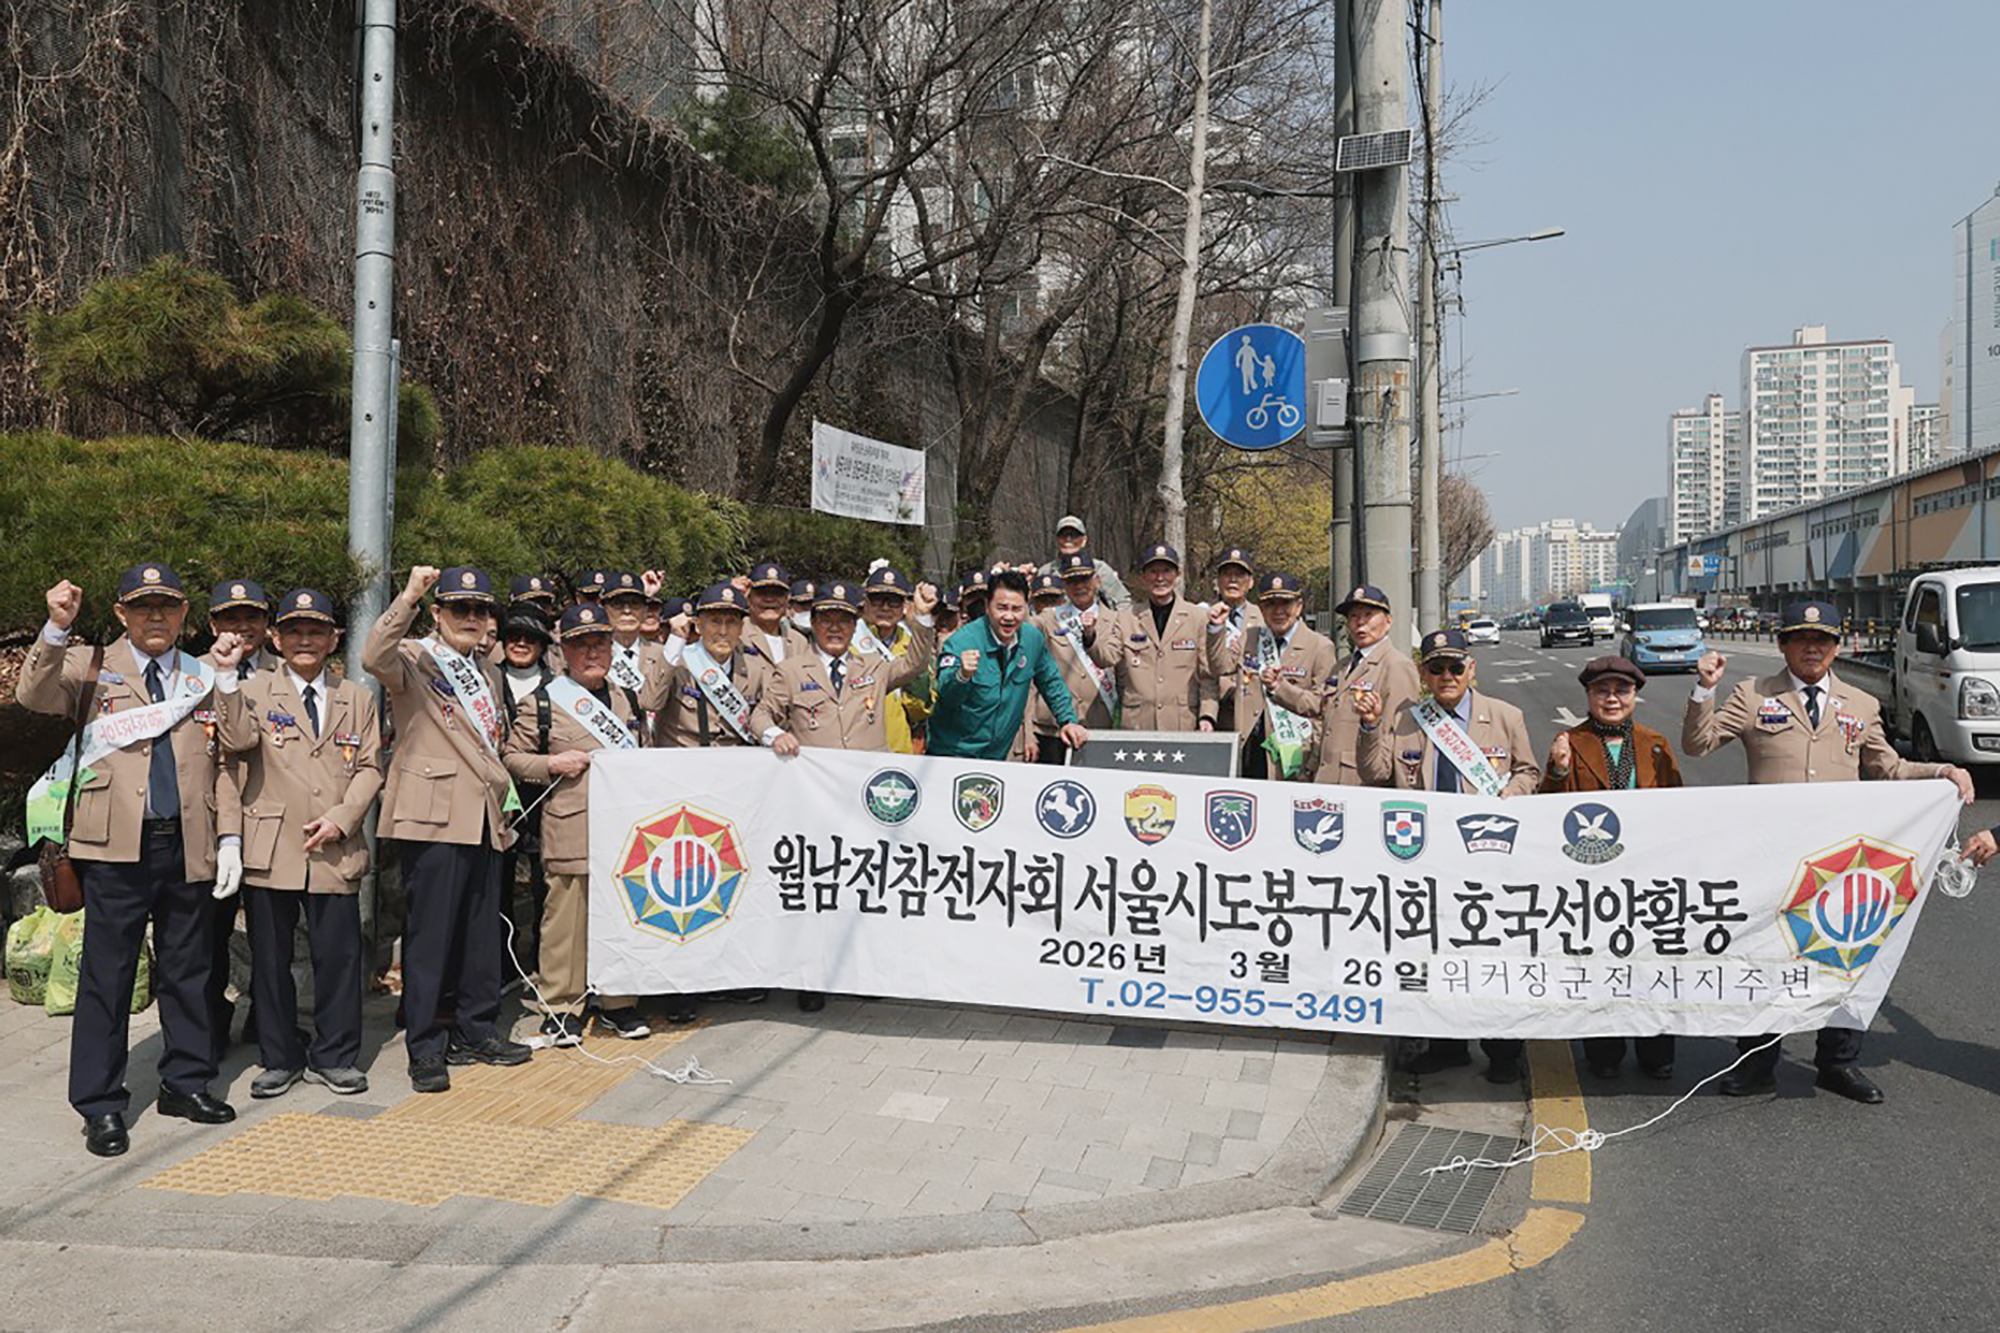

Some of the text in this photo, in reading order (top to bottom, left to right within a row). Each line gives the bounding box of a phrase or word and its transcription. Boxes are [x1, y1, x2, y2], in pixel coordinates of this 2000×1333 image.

[447, 657, 481, 696] 월남전
[591, 710, 626, 744] 월남전
[1469, 761, 1500, 796] 봉사대
[768, 834, 1749, 957] 월남전참전자회 서울시도봉구지회 호국선양활동
[1079, 976, 1383, 1025] T.02-955-3491
